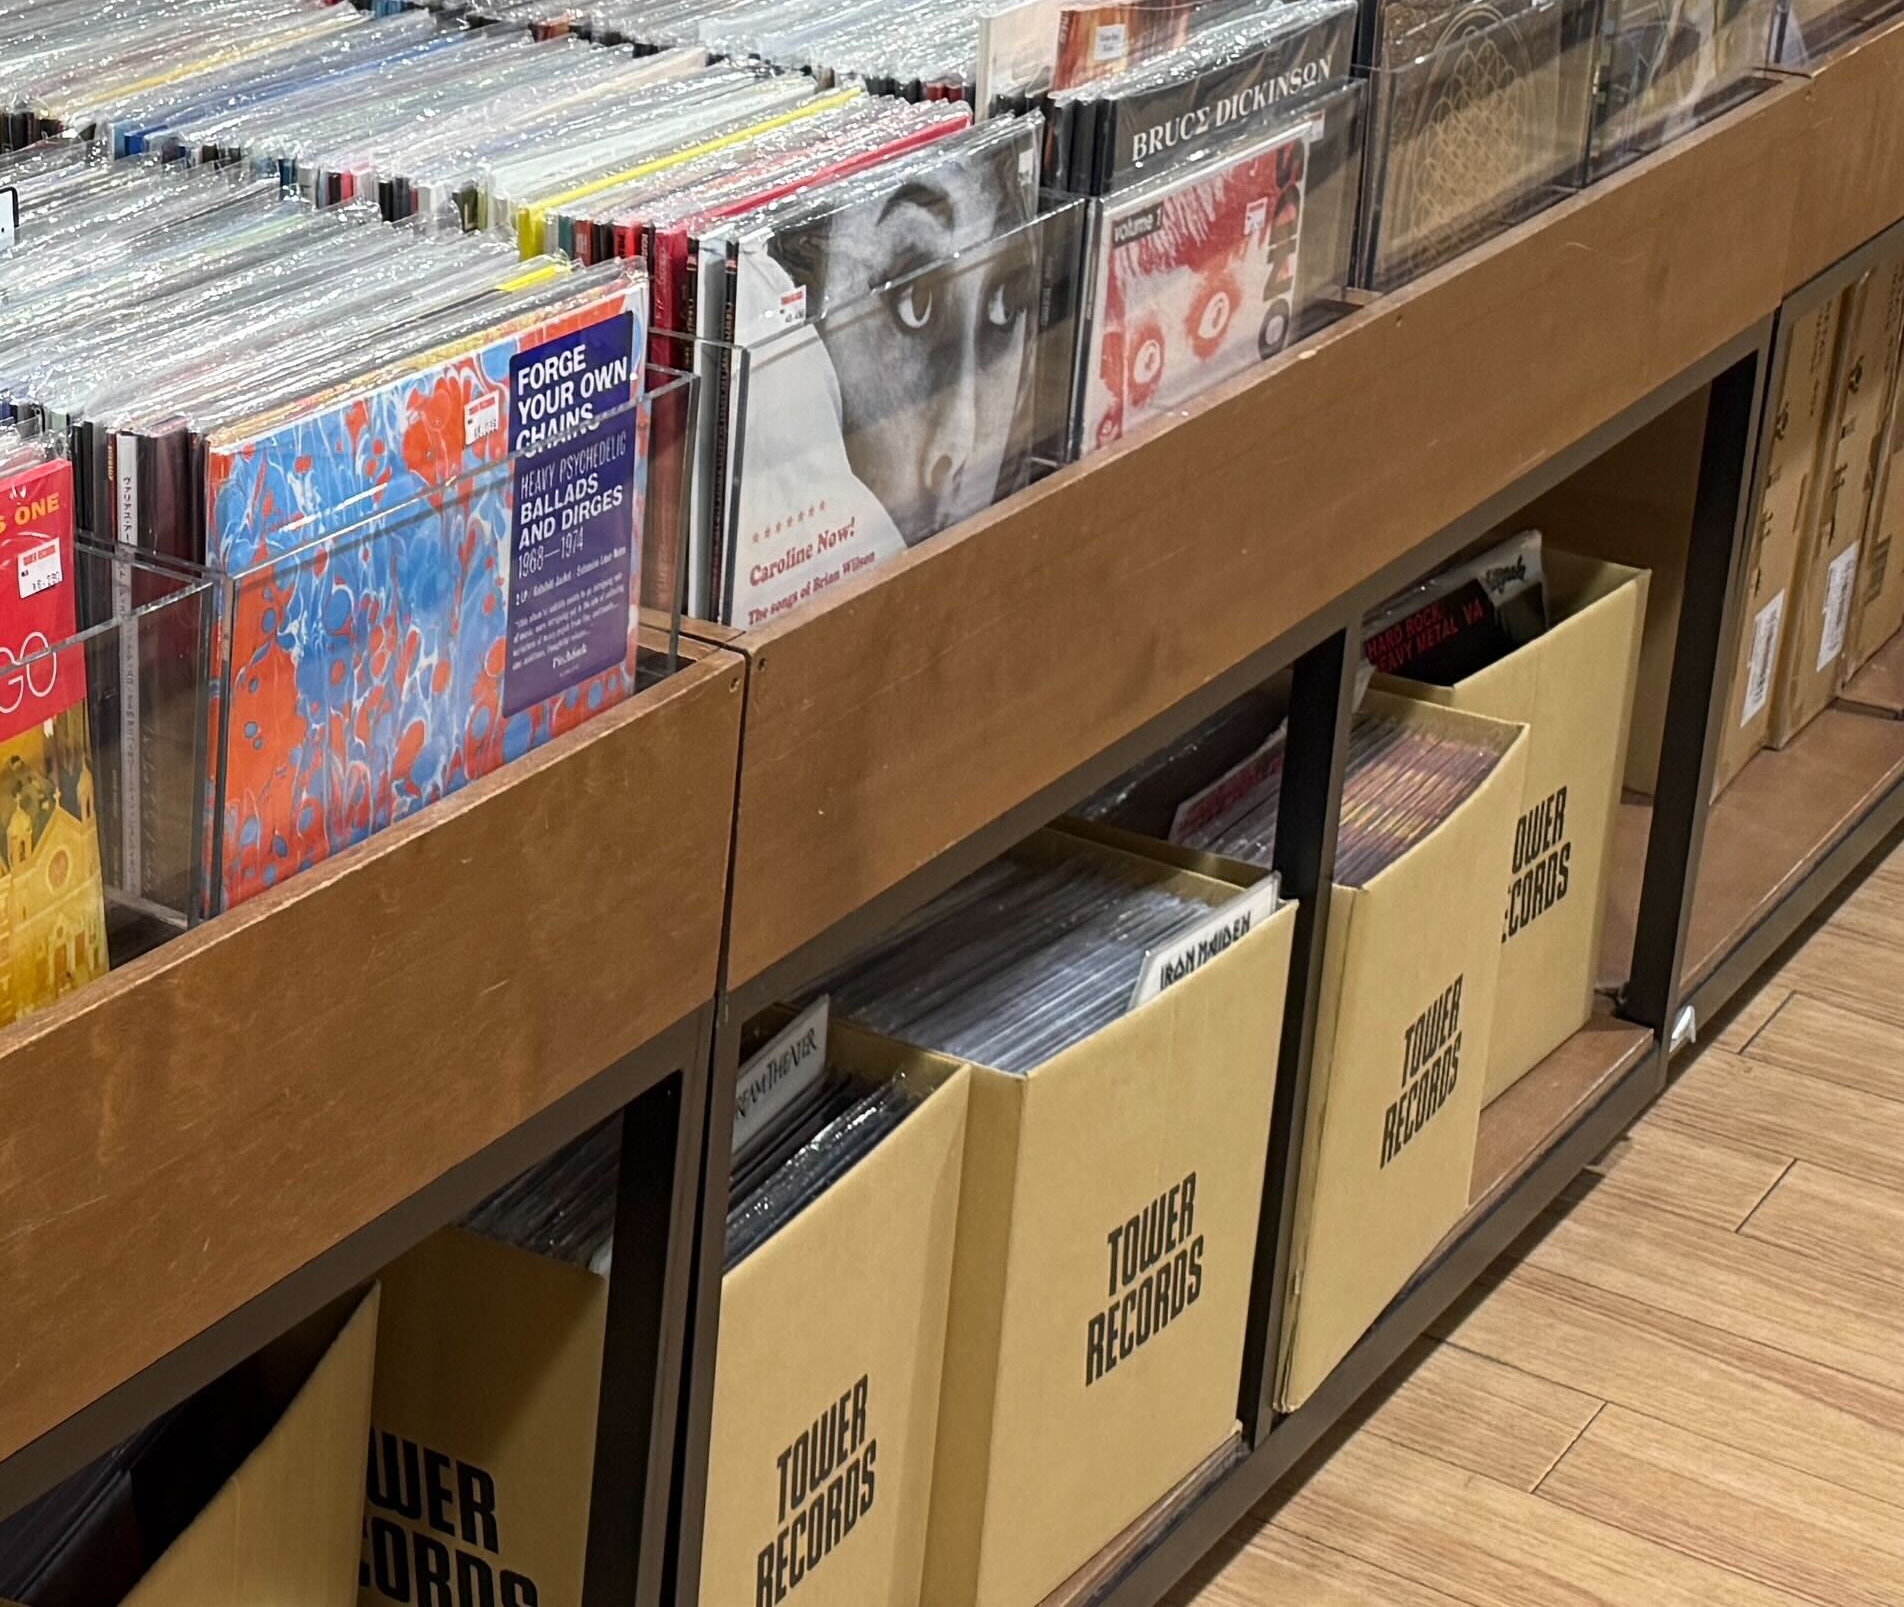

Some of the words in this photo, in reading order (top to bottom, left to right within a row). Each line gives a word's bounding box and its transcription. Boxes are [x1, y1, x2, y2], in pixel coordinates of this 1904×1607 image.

[517, 344, 586, 397] FORGE
[518, 381, 574, 425] YOUR
[516, 403, 600, 458] CHAINS
[520, 464, 556, 500] HEAVY
[560, 438, 626, 488] PSYCHEDELIC
[520, 473, 598, 525] BALLADS
[14, 493, 61, 531] ONE
[518, 516, 556, 550] AND
[561, 485, 623, 530] DIRGES
[748, 606, 769, 626] The
[770, 590, 799, 615] songs
[799, 579, 812, 599] of
[812, 570, 840, 592] Brian
[842, 551, 876, 577] Wilson
[749, 544, 814, 587] Caroline
[817, 516, 856, 555] Now!
[1364, 625, 1405, 660] HARD
[1405, 602, 1442, 637] ROCK
[1375, 641, 1414, 675] EAVY
[1511, 785, 1568, 875] OWER
[1501, 840, 1571, 945] CORDS
[1160, 945, 1196, 992] IRON
[1196, 910, 1252, 967] MAIDEN
[1400, 971, 1464, 1091] TOWER
[1378, 1030, 1463, 1171] RECORDS
[1105, 1170, 1198, 1298] TOWER
[1084, 1233, 1205, 1388] RECORDS
[775, 1372, 869, 1525] TOWER
[366, 1424, 499, 1554] WER
[755, 1438, 878, 1607] RECORDS
